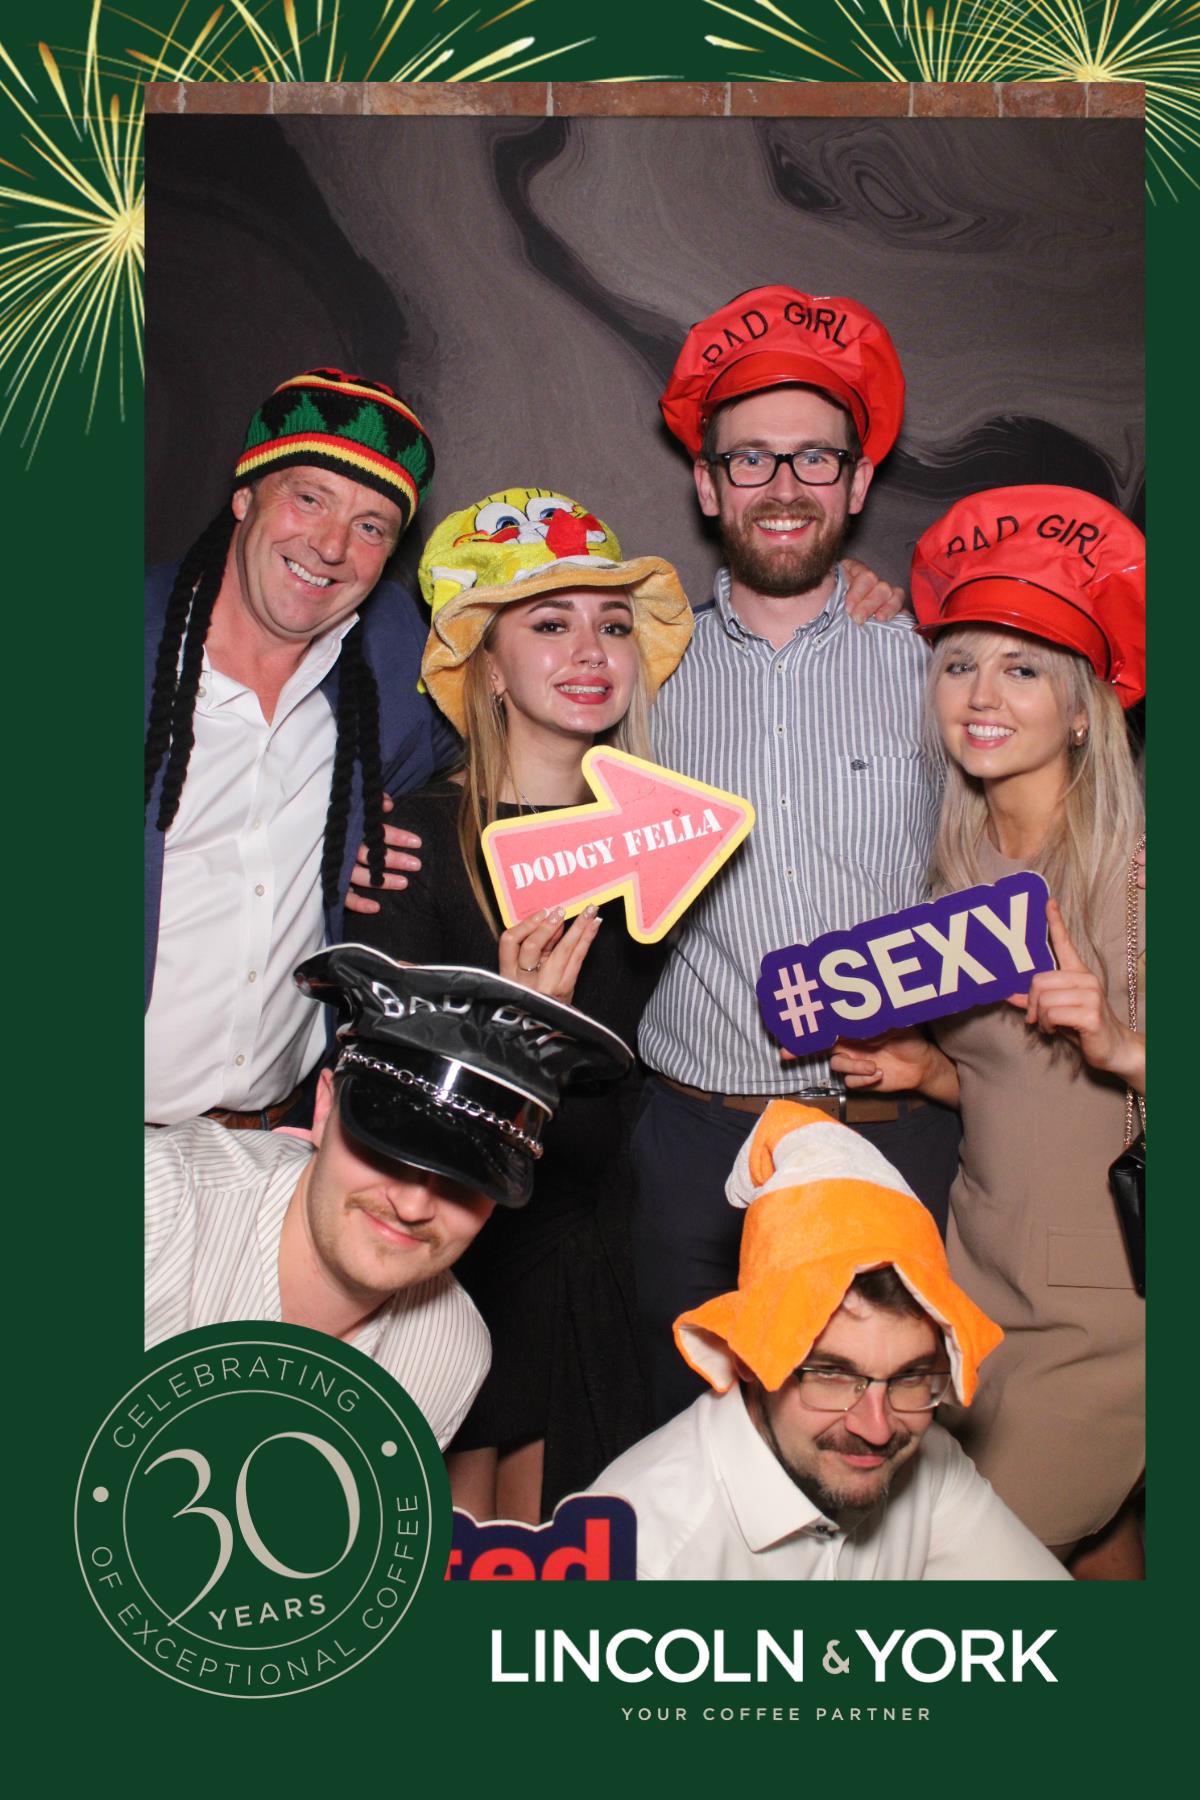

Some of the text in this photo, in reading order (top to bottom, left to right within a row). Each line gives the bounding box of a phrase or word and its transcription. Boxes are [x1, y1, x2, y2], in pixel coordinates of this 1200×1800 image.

[784, 302, 848, 349] GIRL
[1037, 514, 1107, 568] GIRL
[509, 808, 723, 890] DODGY FELLA
[773, 891, 1036, 1038] #SEXY
[372, 981, 474, 1018] BAD
